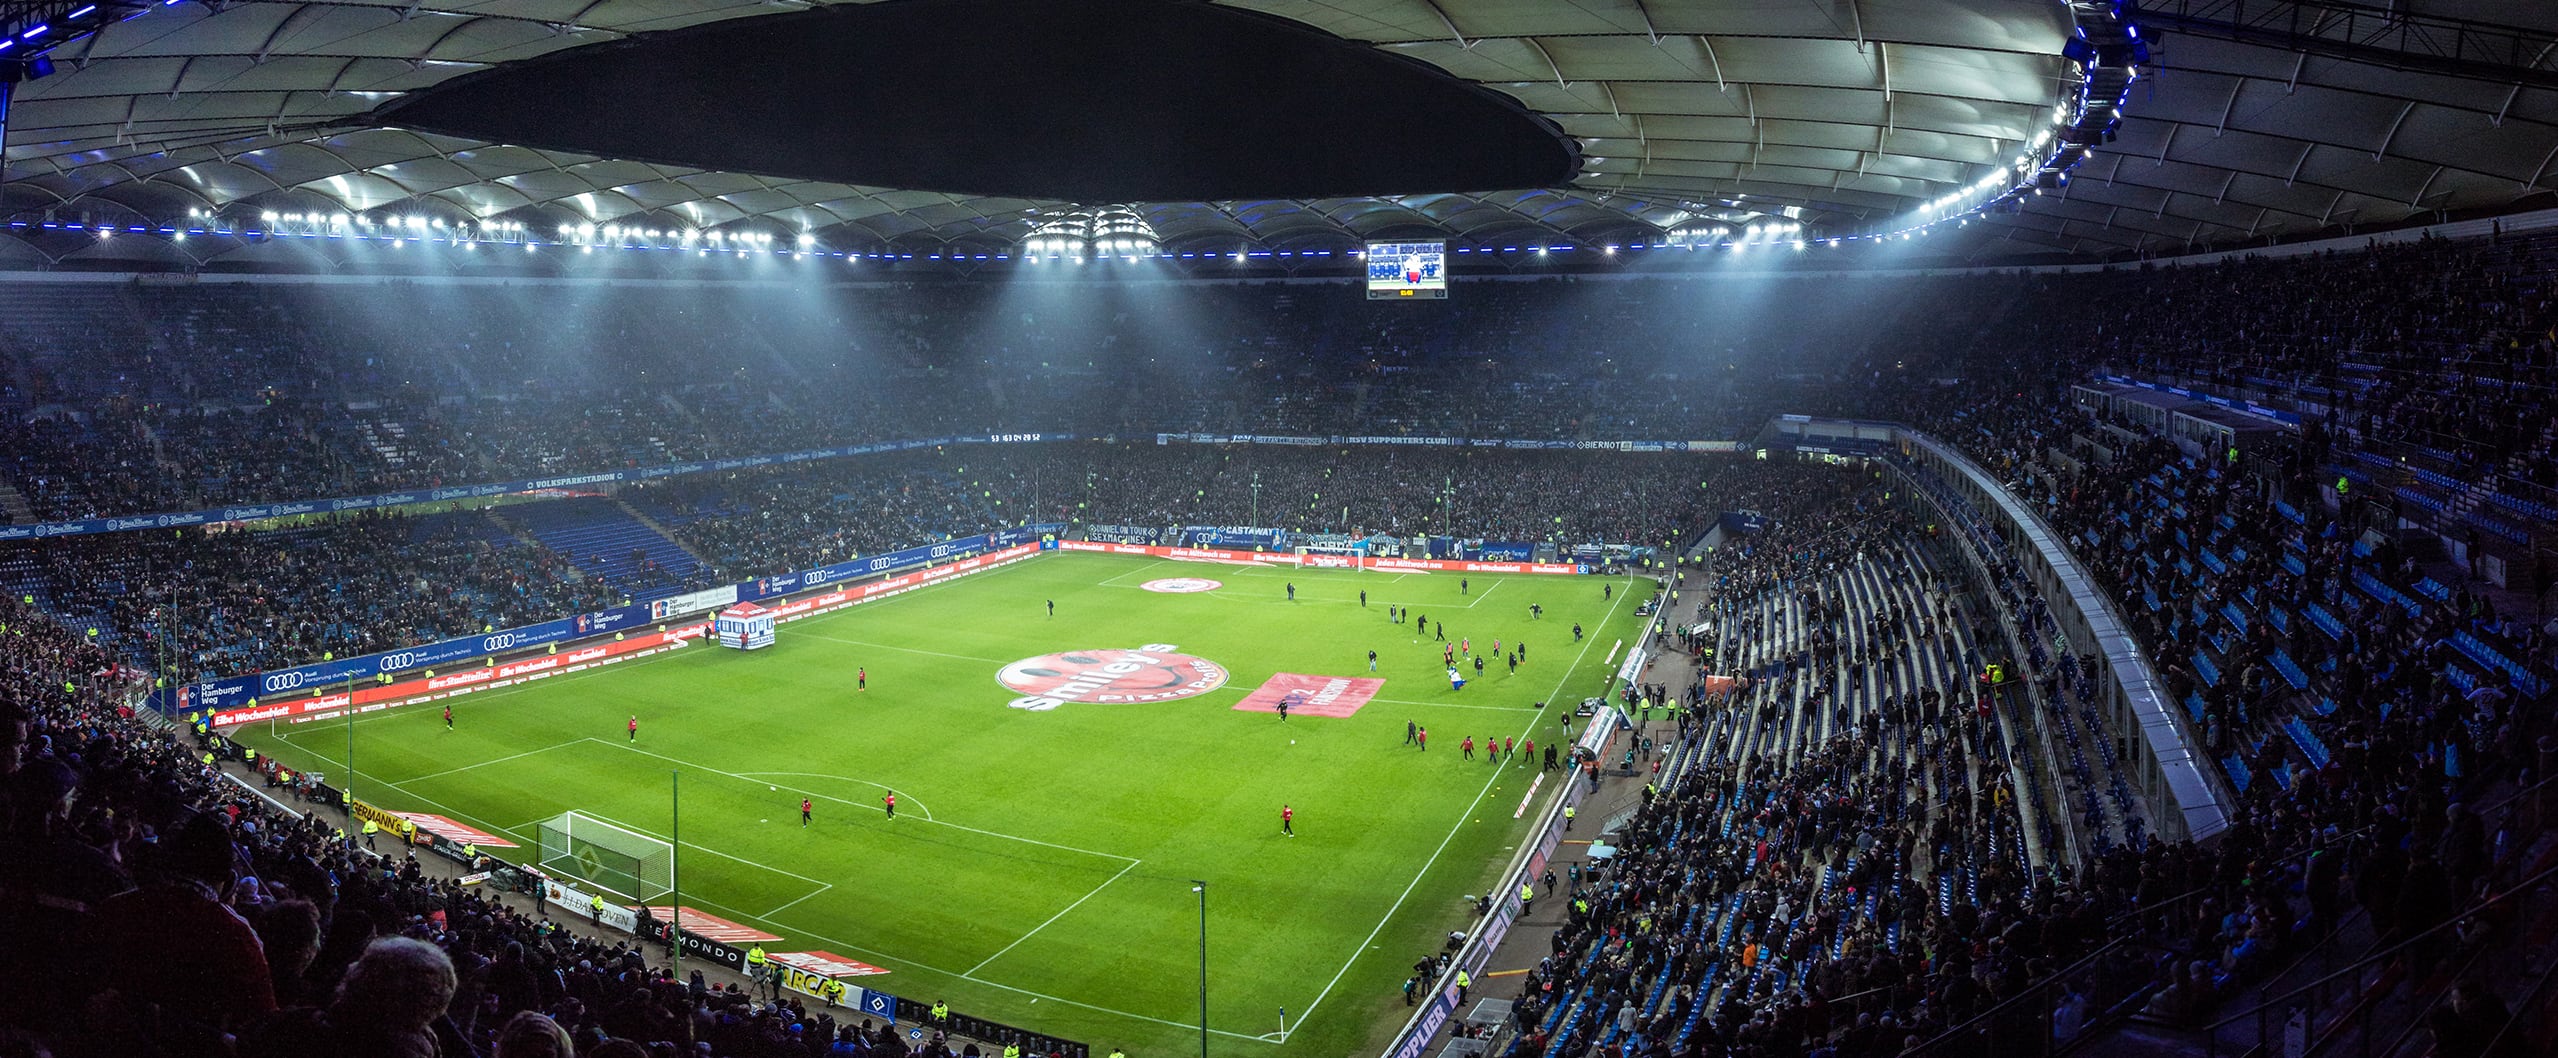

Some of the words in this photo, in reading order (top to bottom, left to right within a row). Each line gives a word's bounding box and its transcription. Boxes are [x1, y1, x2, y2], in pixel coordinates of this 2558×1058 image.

[536, 474, 615, 488] VOLKSPARKSTADION
[1096, 524, 1119, 534] DANIEL
[1130, 526, 1147, 536] TOUR
[1393, 559, 1428, 568] Mittwoch
[594, 613, 623, 625] Hamburger
[594, 622, 606, 631] Weg
[304, 674, 331, 683] Vorsprung
[1009, 643, 1178, 711] Smileys
[201, 685, 243, 698] Hamburger
[201, 697, 219, 705] Weg
[304, 697, 352, 711] Wochenblat
[215, 714, 234, 725] Elbe
[235, 706, 290, 722] Wochenblatt
[765, 961, 846, 1004] TARCAR
[1397, 1004, 1447, 1058] PPLIER
